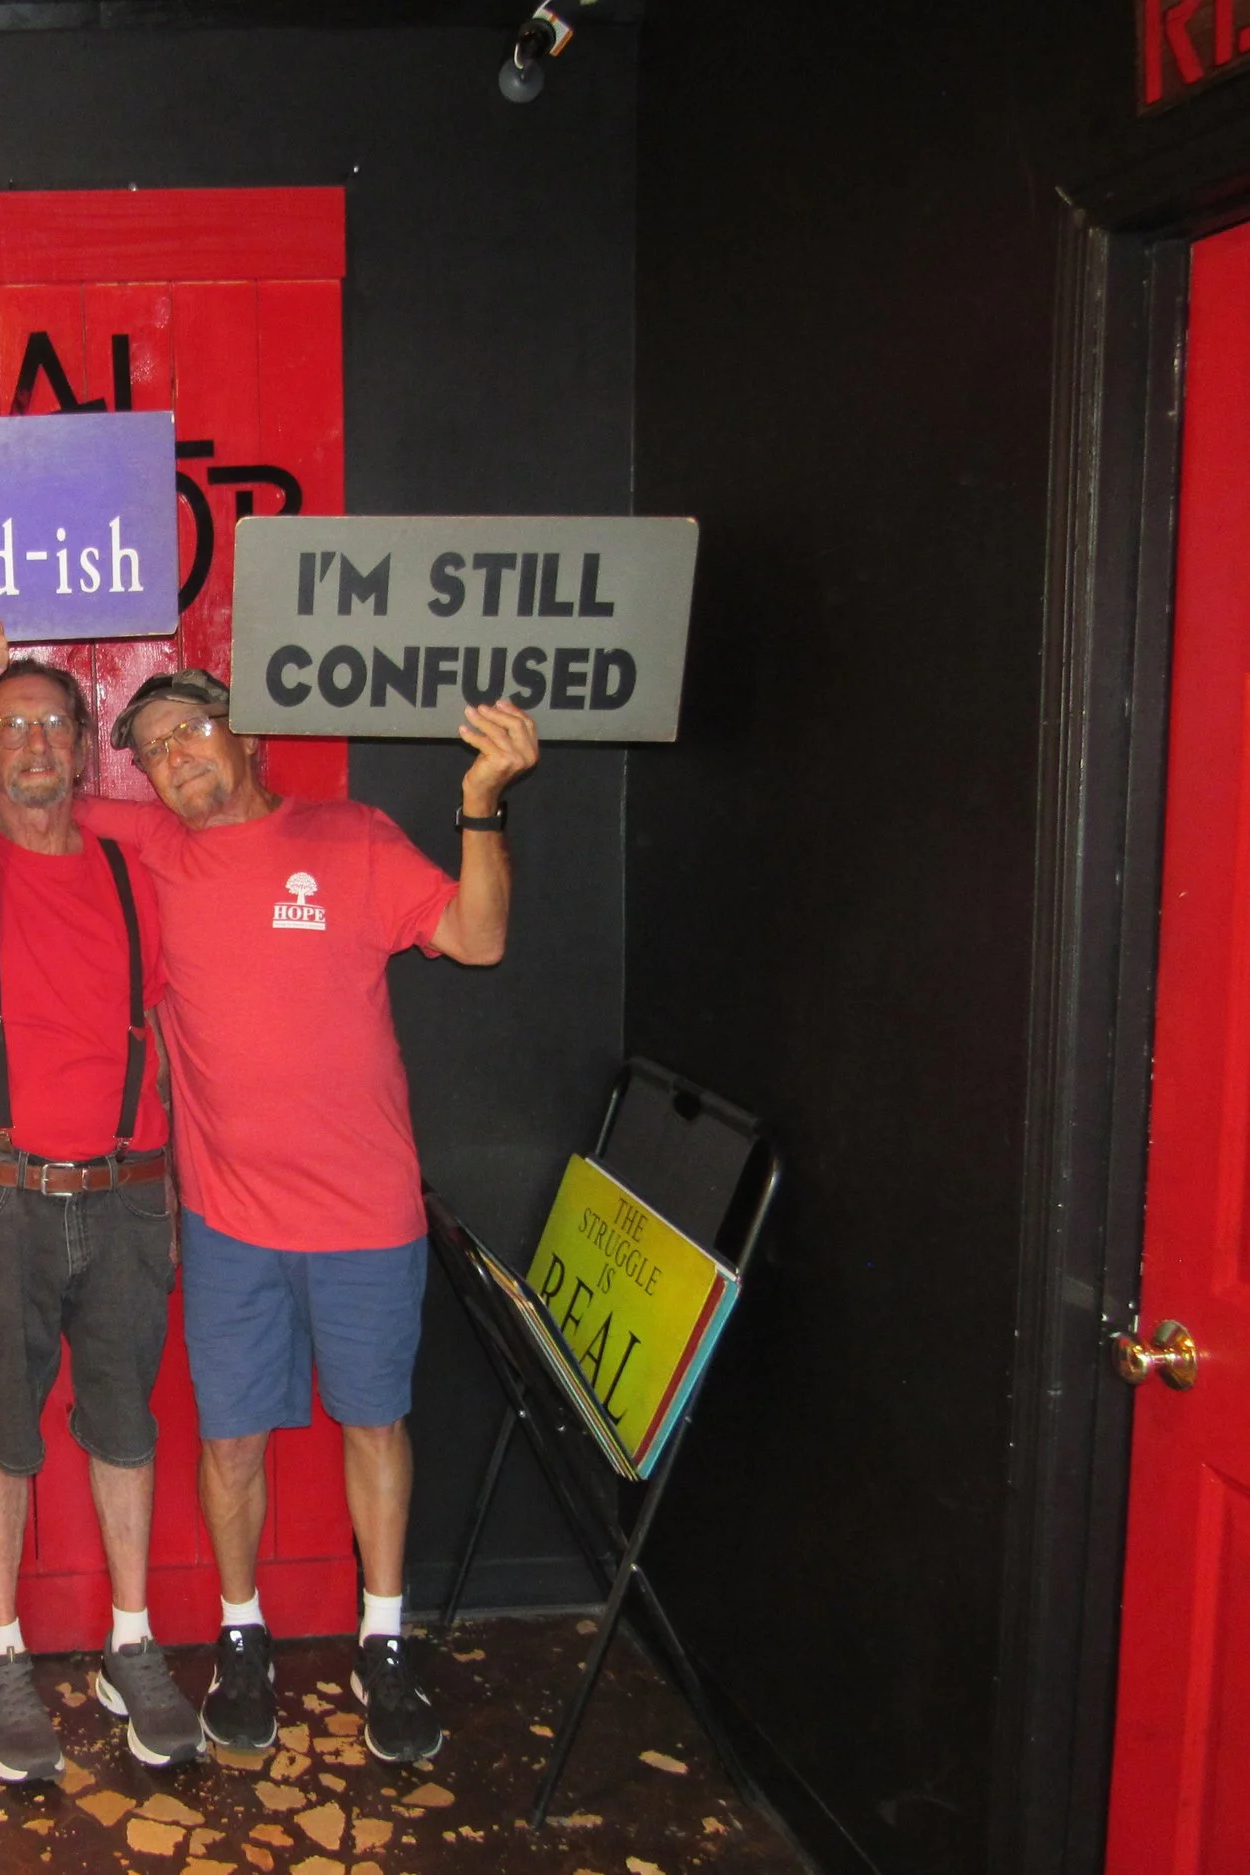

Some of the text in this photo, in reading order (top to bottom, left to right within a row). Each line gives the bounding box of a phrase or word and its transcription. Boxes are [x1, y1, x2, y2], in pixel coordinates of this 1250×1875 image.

[297, 551, 615, 618] I'M STILL
[265, 644, 637, 711] CONFUSED
[273, 905, 326, 923] HOPE
[610, 1197, 649, 1241] THE
[578, 1207, 663, 1297] STRUGGLE
[596, 1264, 617, 1295] IS
